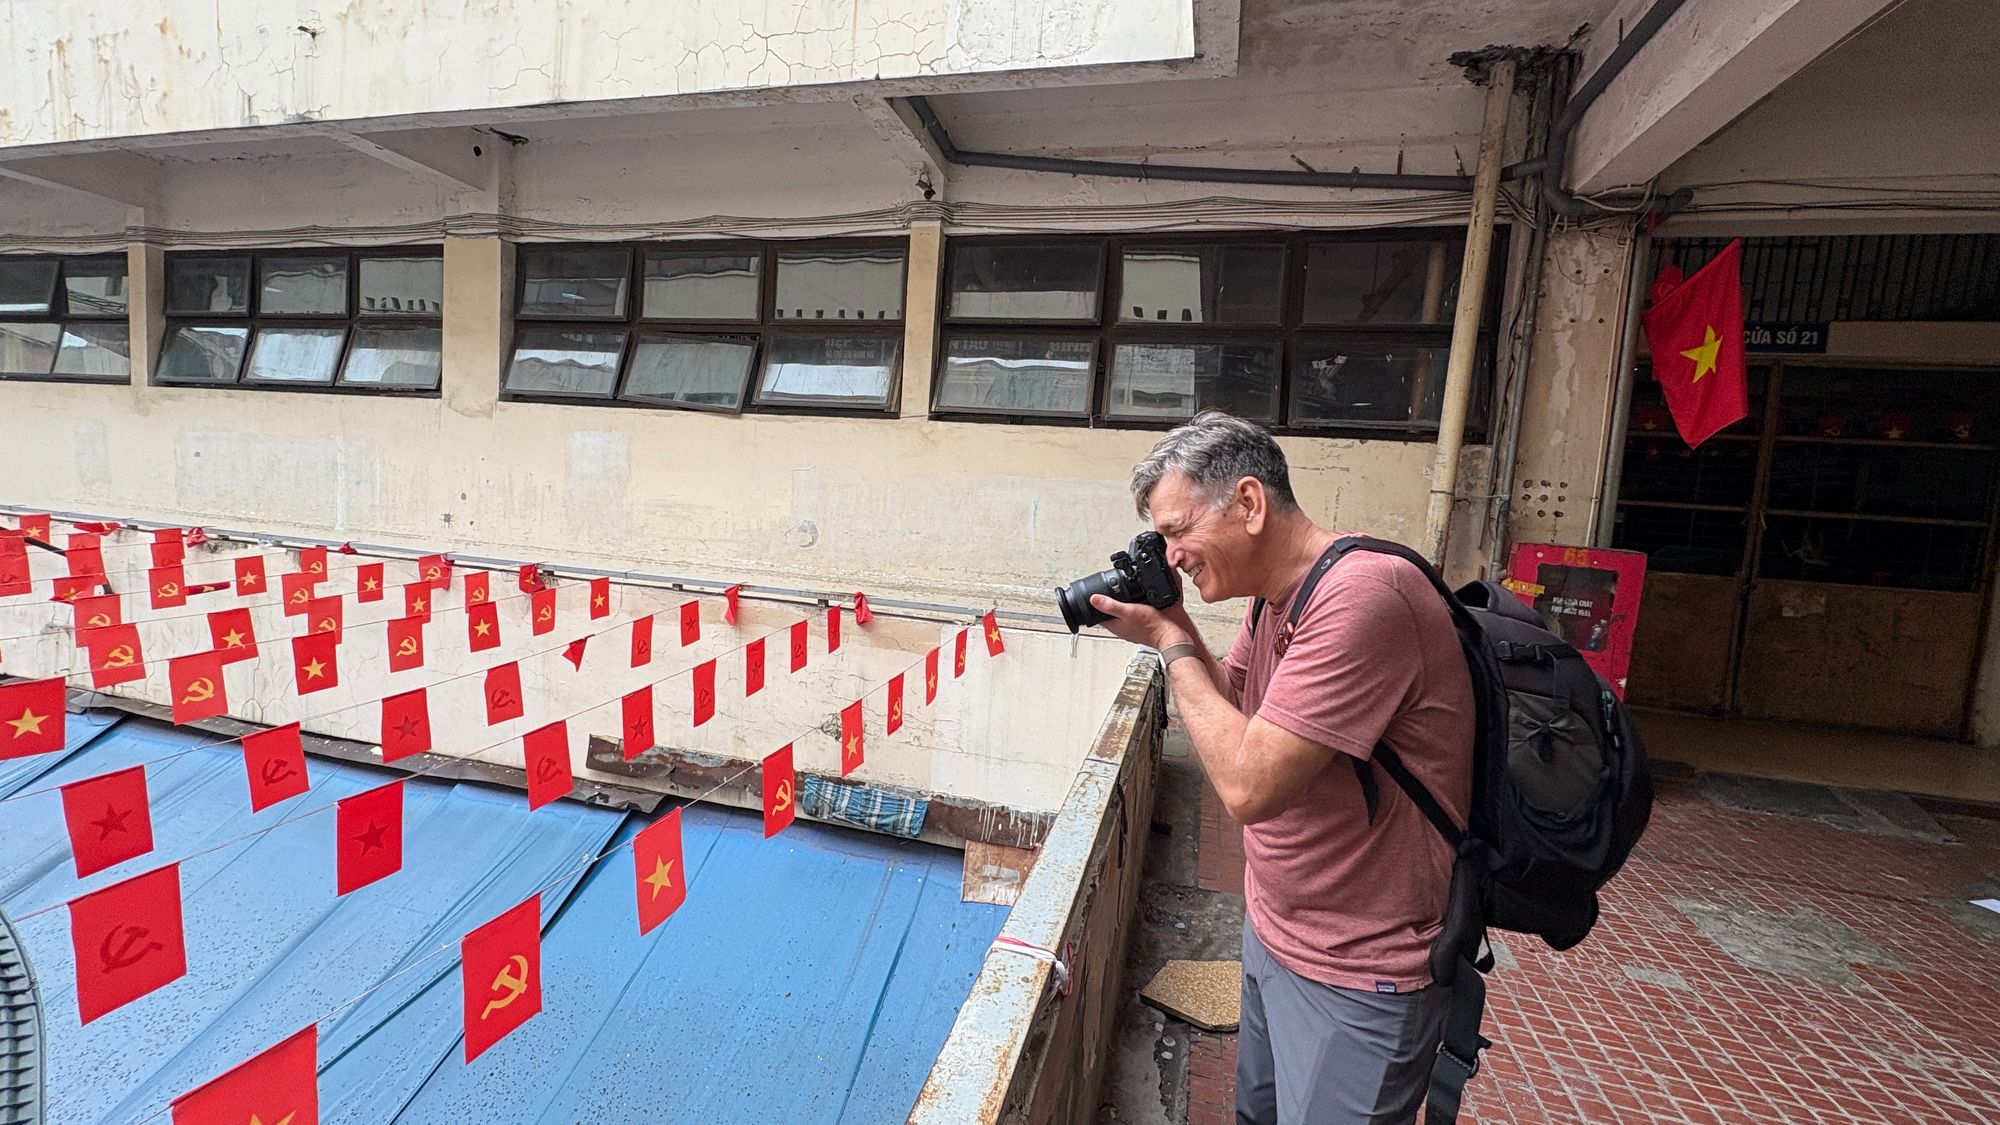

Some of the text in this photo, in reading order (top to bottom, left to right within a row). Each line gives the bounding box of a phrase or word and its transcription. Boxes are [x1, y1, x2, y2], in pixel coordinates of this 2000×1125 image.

[1744, 326, 1818, 345] CỬA SỐ 21
